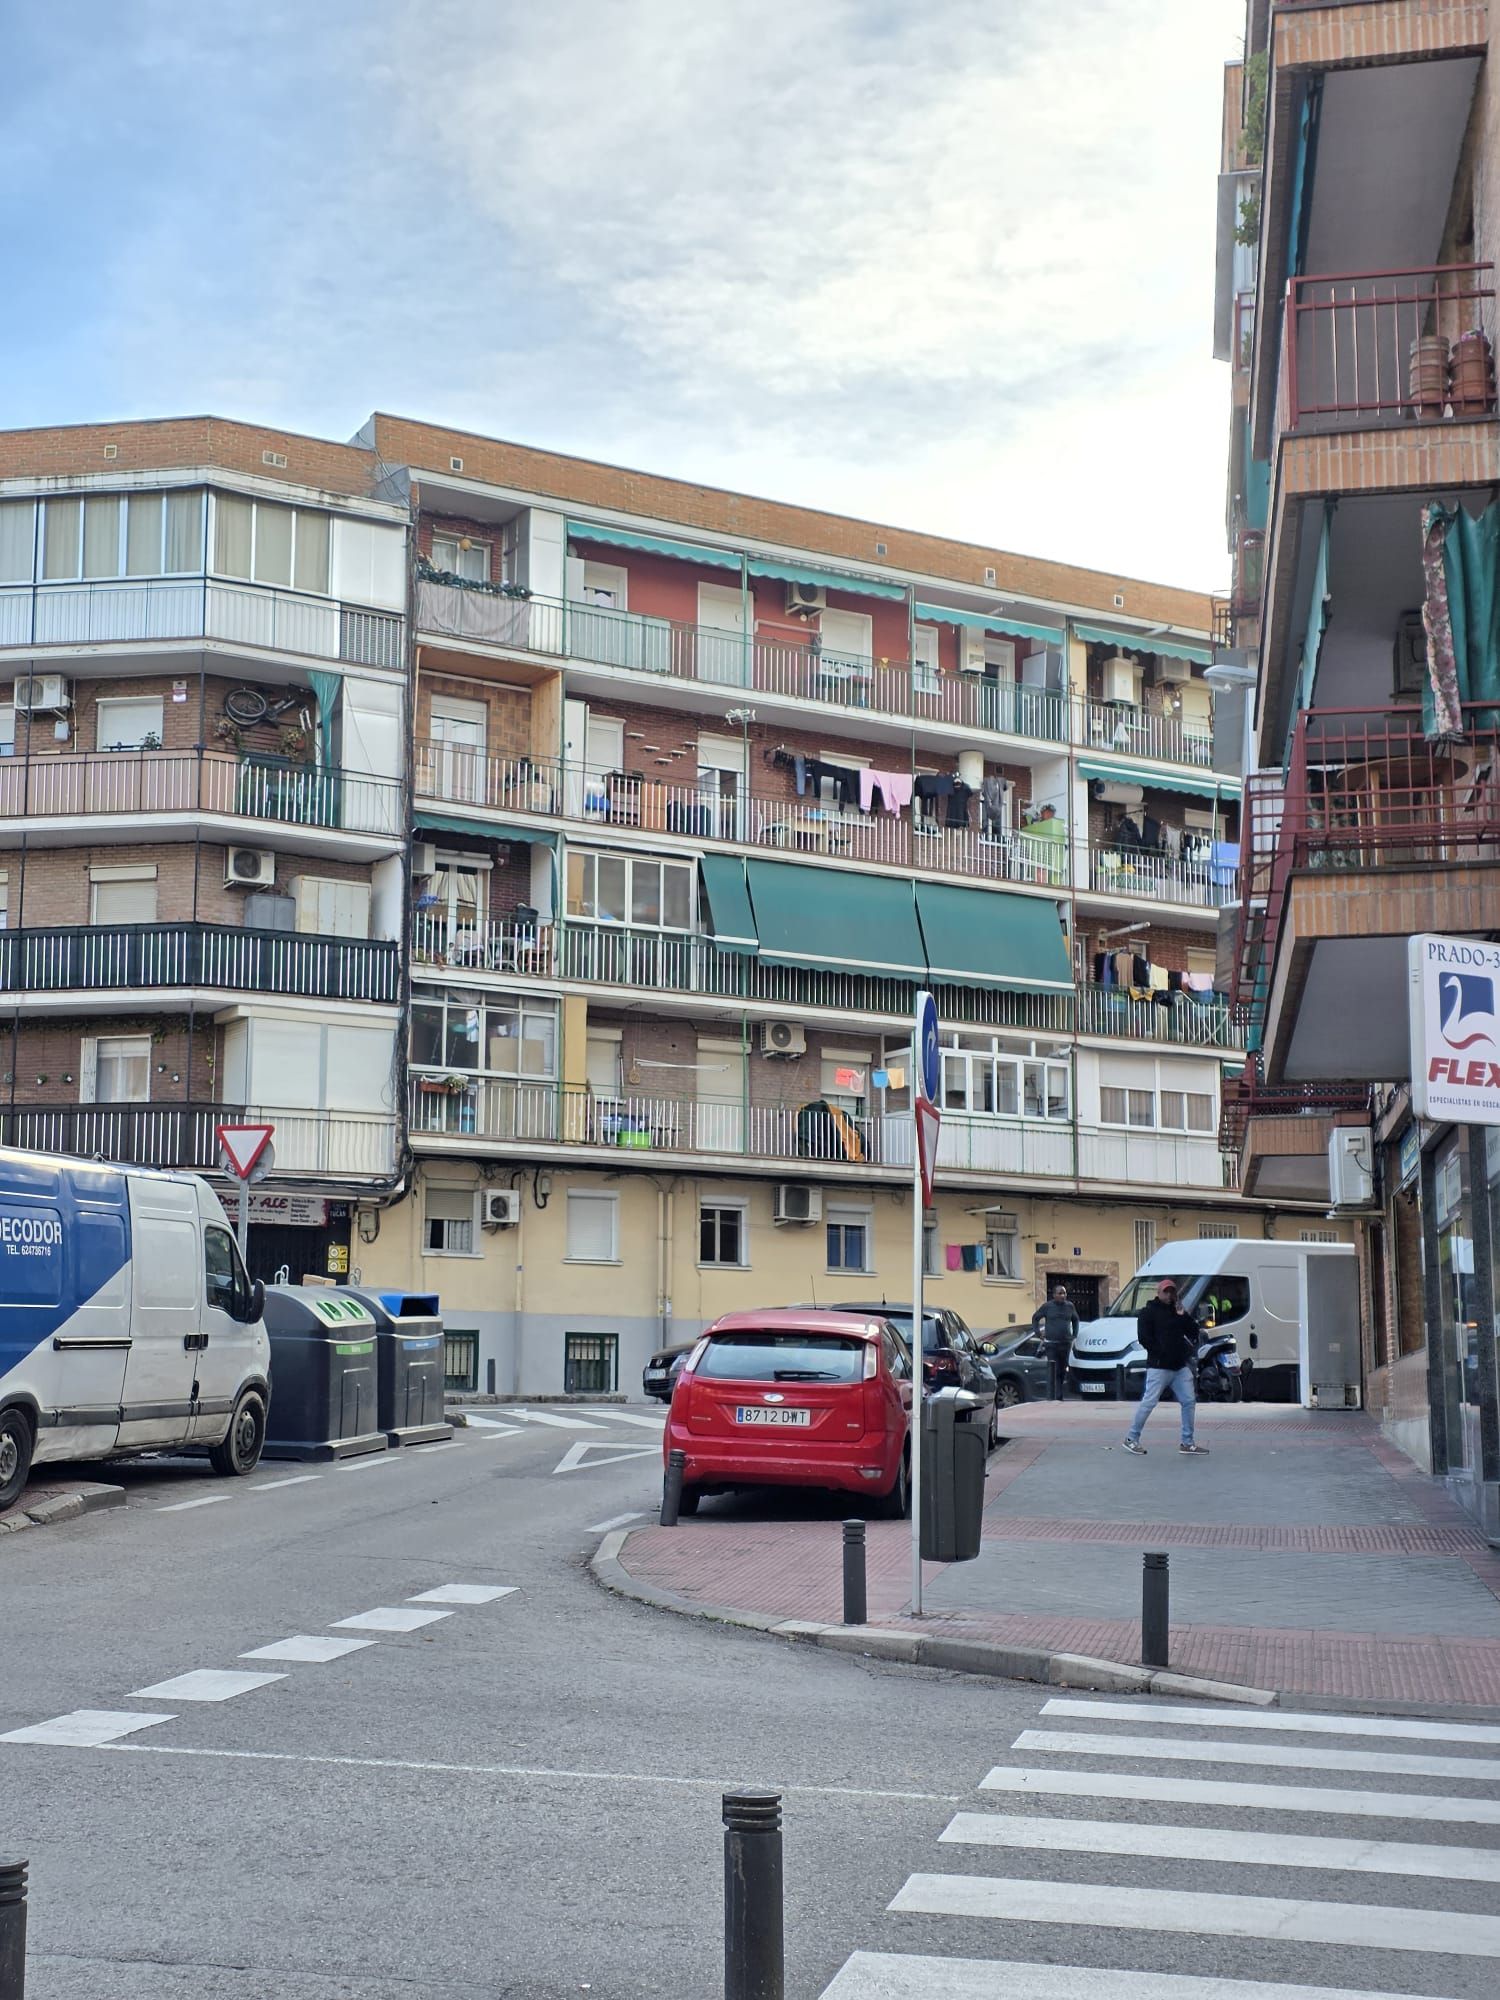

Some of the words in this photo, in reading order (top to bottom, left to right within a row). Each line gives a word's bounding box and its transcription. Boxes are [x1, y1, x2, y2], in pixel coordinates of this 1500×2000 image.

[1428, 1057, 1500, 1088] FLEX
[1429, 1096, 1471, 1106] ESPECIALISTAS
[1473, 1099, 1480, 1107] EN
[0, 1217, 62, 1244] ECODOR
[1085, 1338, 1108, 1346] IVECO
[745, 1409, 777, 1423] 8712
[782, 1410, 806, 1424] DWT
